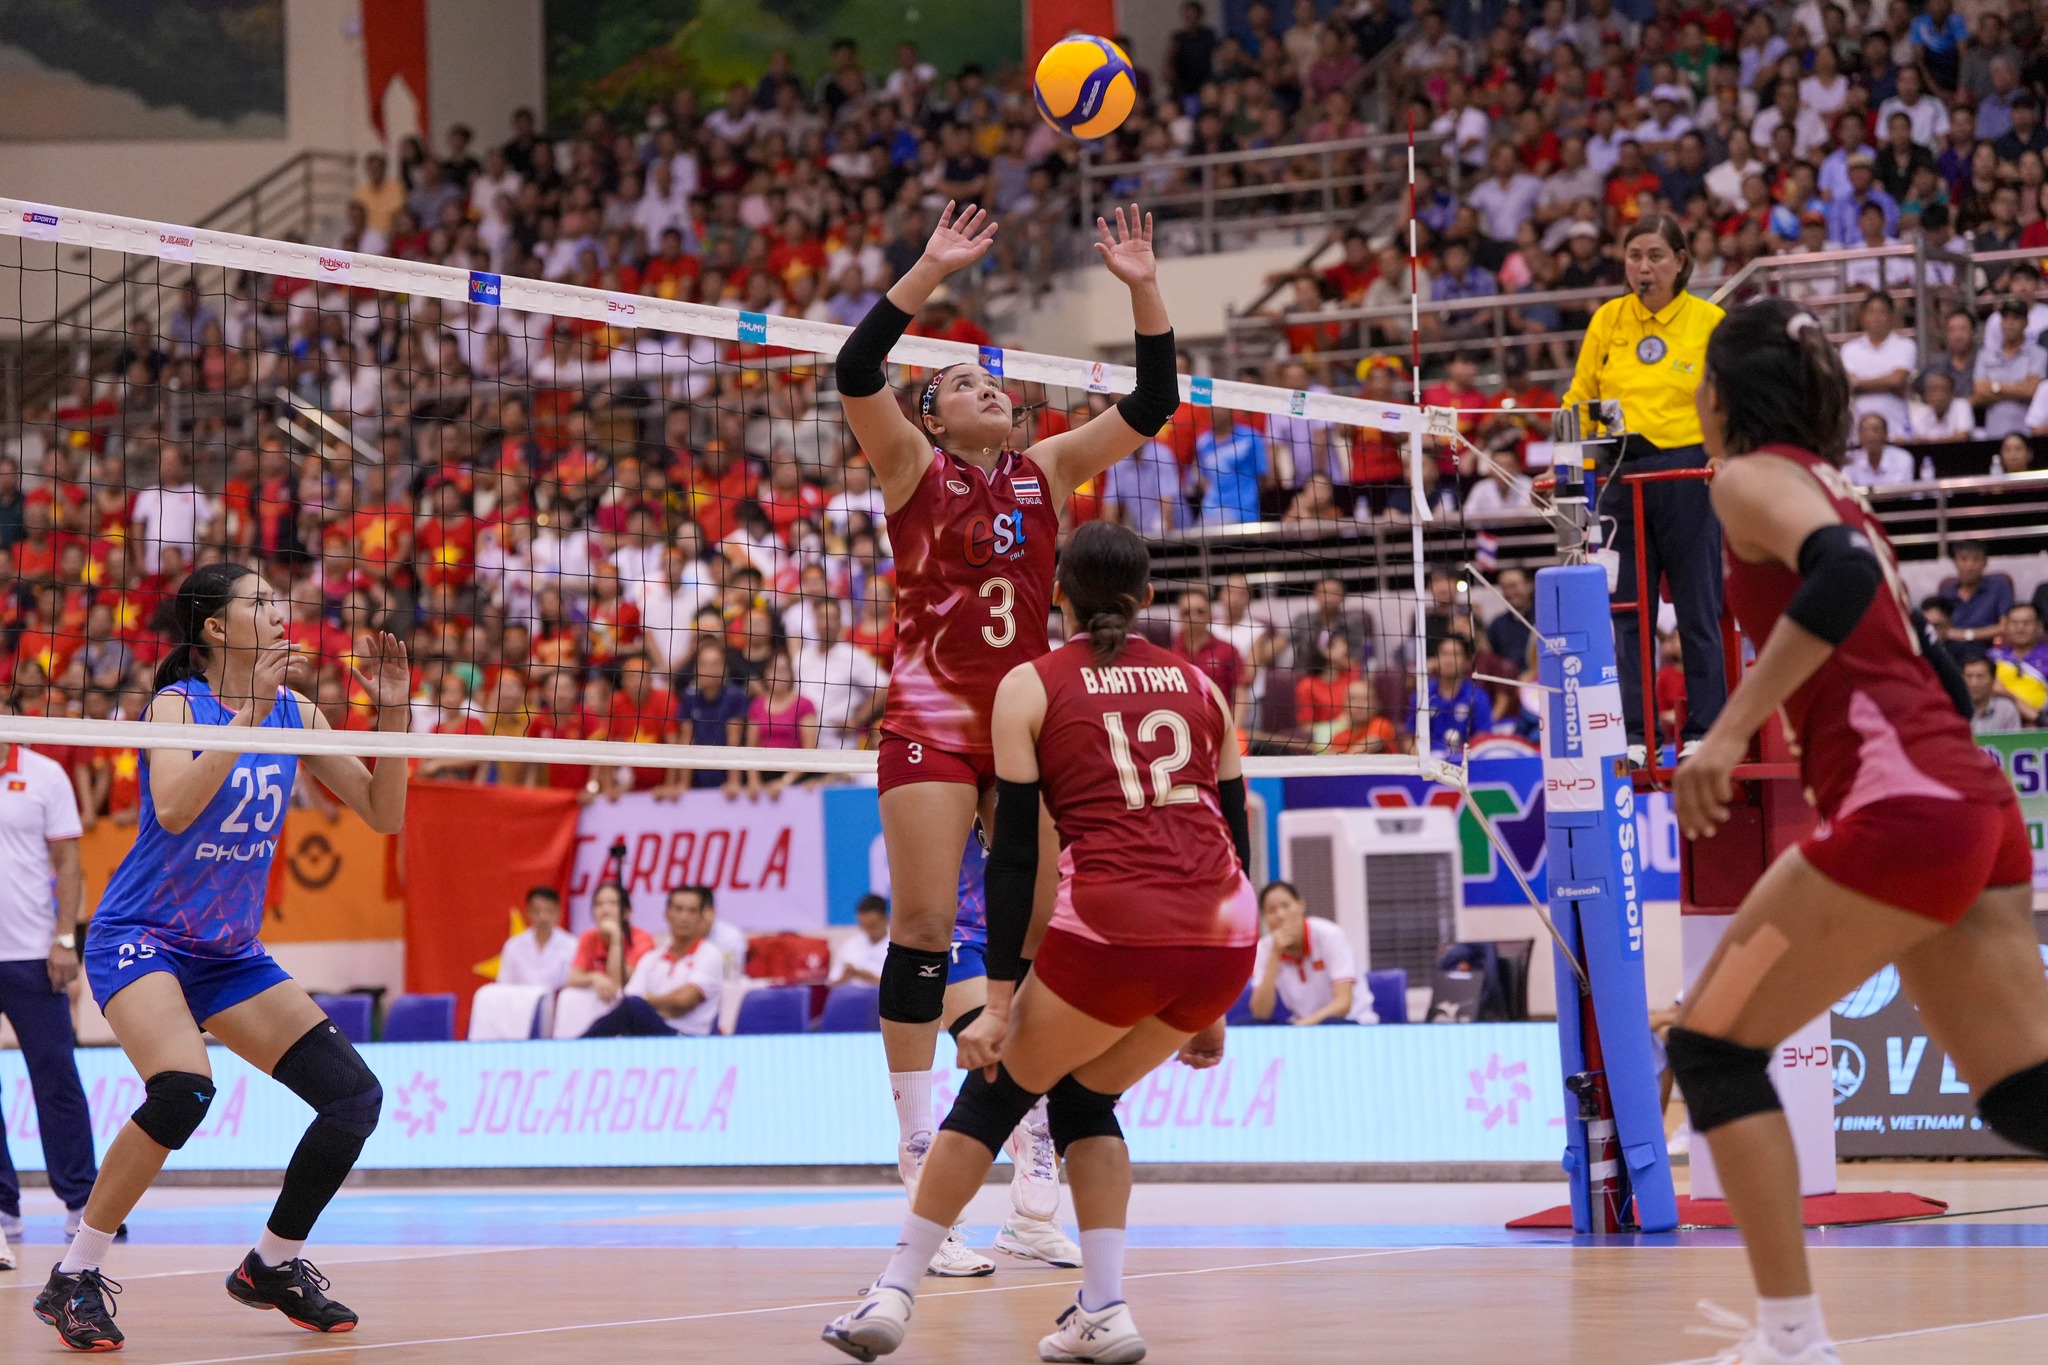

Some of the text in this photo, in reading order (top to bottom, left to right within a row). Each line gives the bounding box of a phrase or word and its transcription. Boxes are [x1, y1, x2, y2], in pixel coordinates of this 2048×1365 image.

[33, 214, 57, 225] SPORTS
[166, 235, 194, 248] JOGARBOLA
[319, 256, 350, 271] Rebisco
[608, 301, 635, 315] BYD
[739, 321, 765, 333] PHUMY
[1017, 497, 1042, 505] THA
[978, 576, 1017, 649] 3
[1079, 666, 1189, 695] B.HATTAYA
[1564, 677, 1582, 750] Senoh
[908, 742, 923, 764] 3
[1102, 709, 1200, 810] 12
[1547, 778, 1595, 791] BYD
[220, 764, 282, 833] 25
[569, 826, 791, 896] GARBOLA
[1564, 886, 1600, 897] Senoh
[1618, 822, 1642, 952] Senoh
[117, 943, 156, 970] 25
[1783, 1046, 1828, 1068] BYD
[458, 1066, 738, 1135] JOGARBOLA
[1890, 1114, 1965, 1131] VIETNAM
